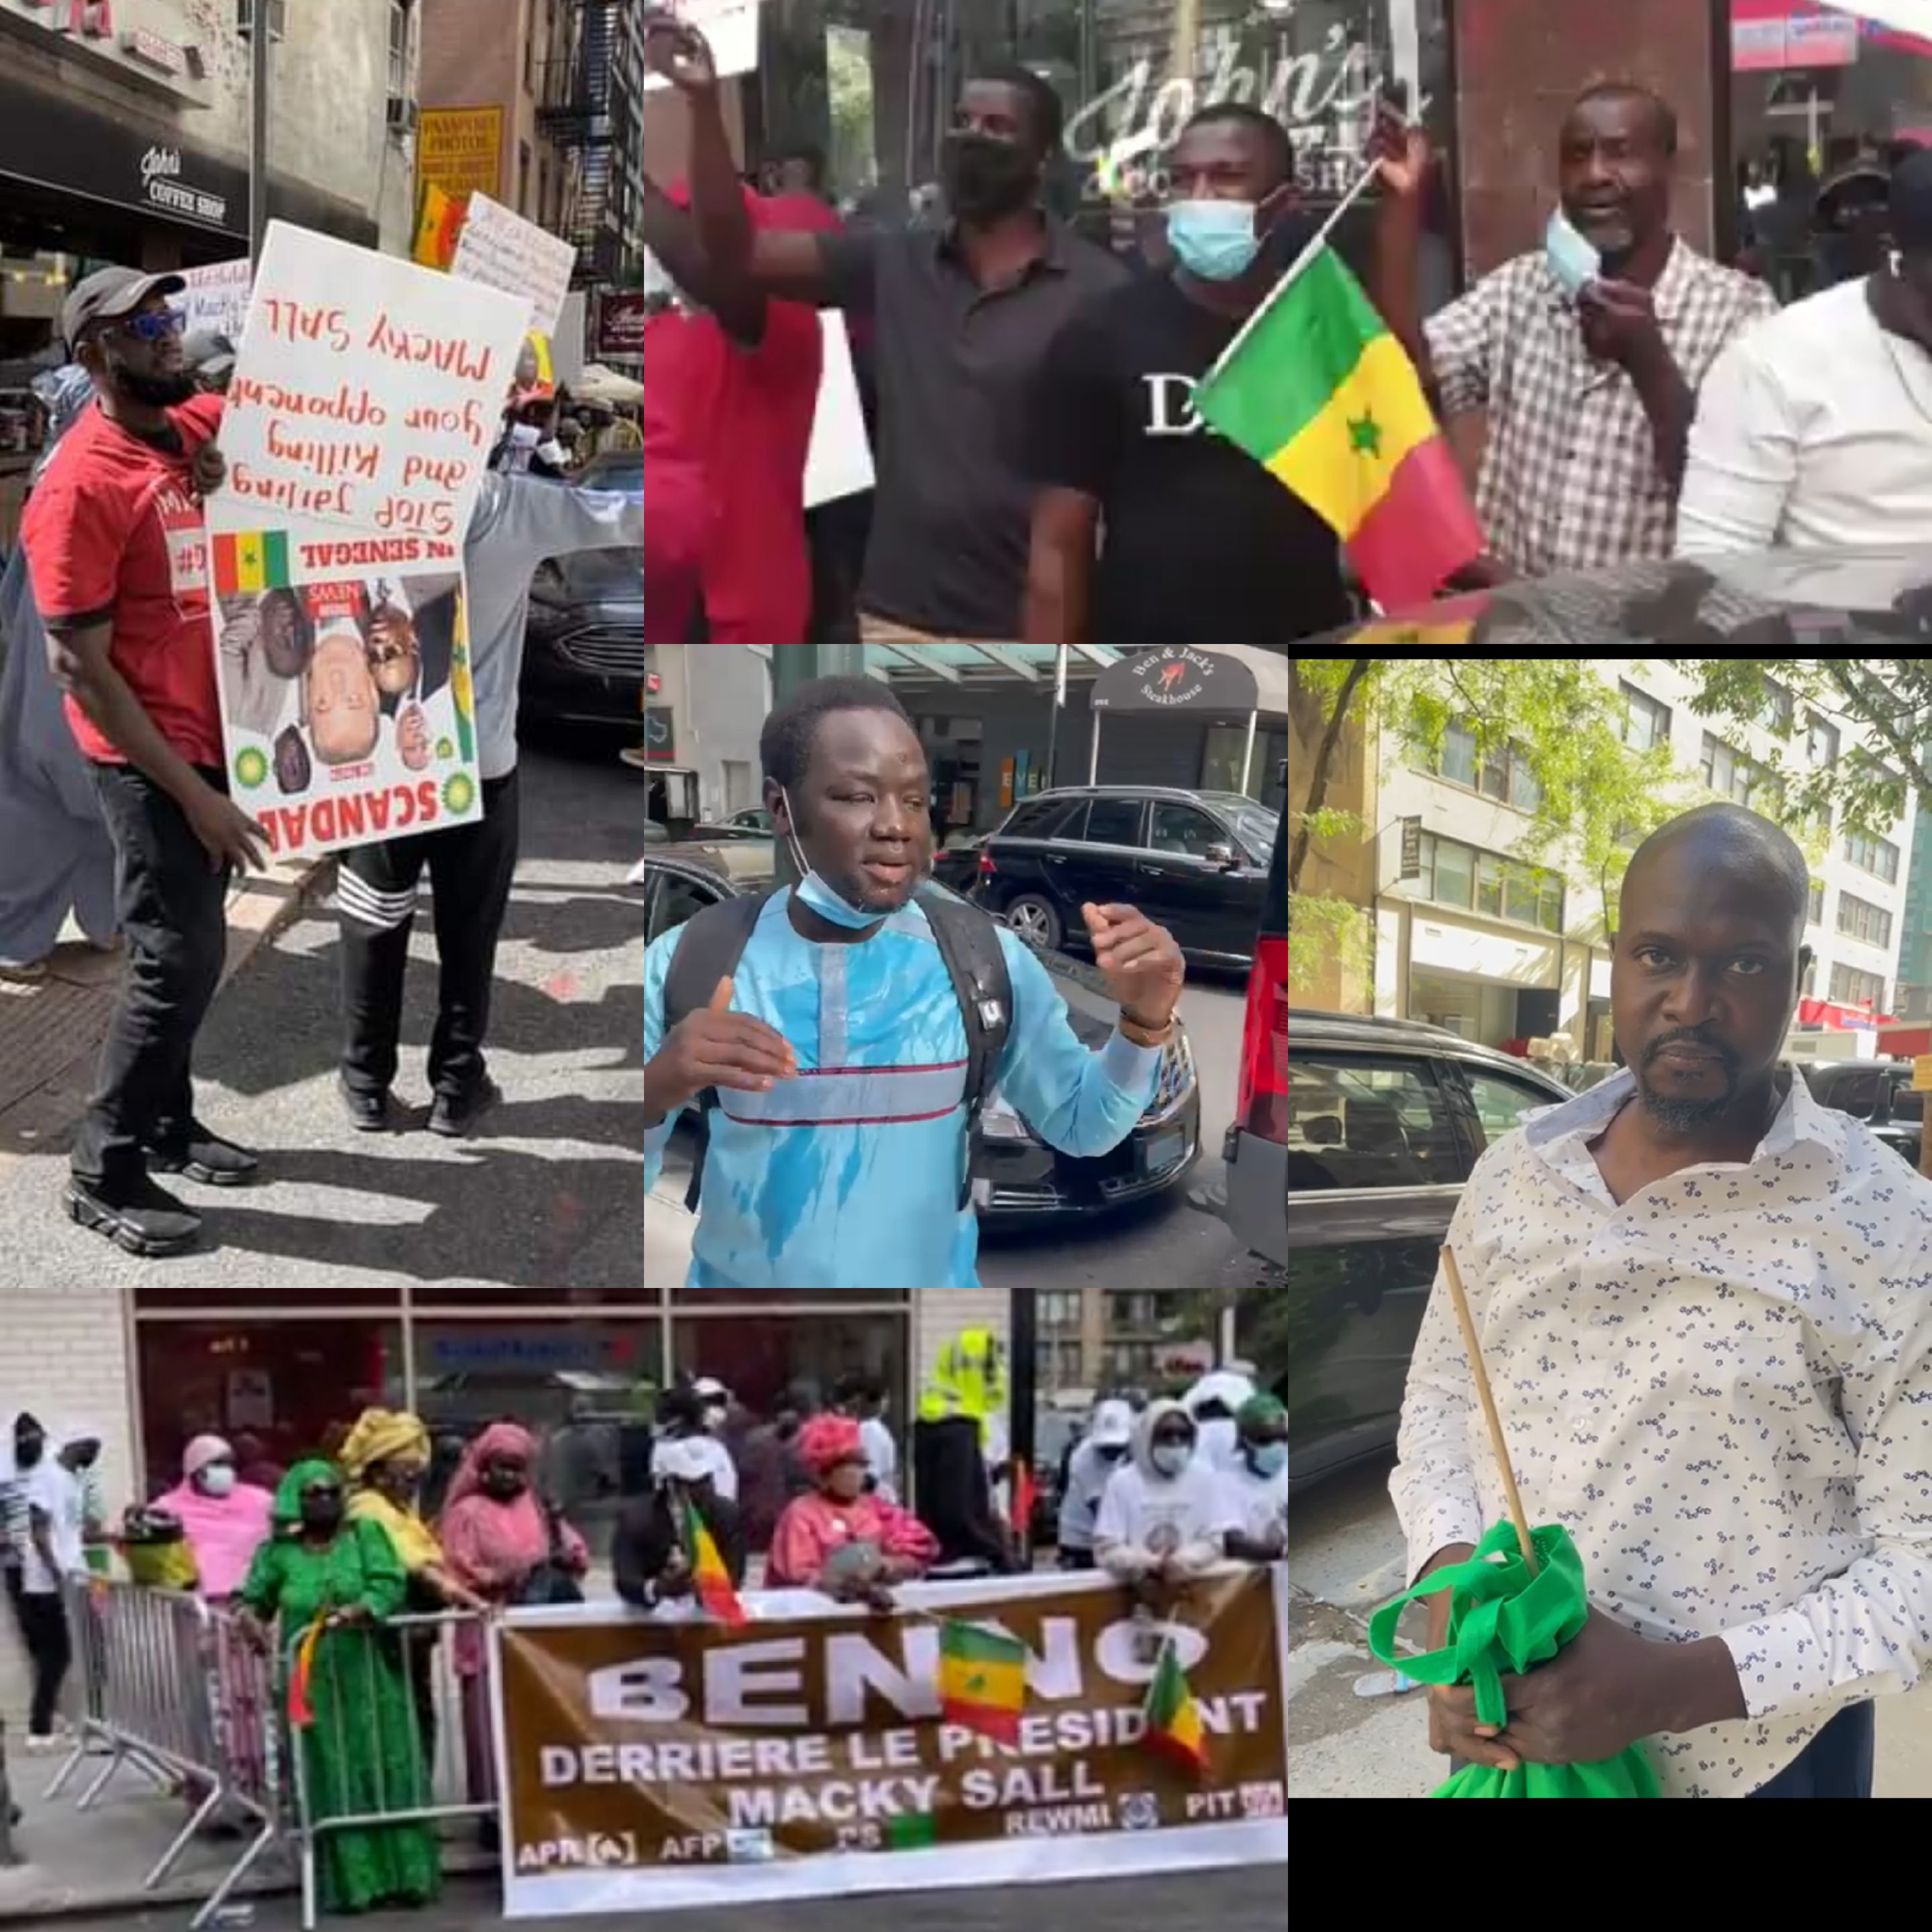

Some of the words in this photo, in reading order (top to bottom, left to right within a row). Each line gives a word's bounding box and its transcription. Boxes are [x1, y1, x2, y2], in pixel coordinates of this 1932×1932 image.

[150, 179, 195, 211] COFFEE
[196, 195, 225, 220] SHOP
[266, 299, 350, 352] SALL
[227, 376, 386, 426] opponent
[404, 399, 482, 445] your
[231, 462, 354, 515] Jailing
[403, 454, 466, 492] and
[300, 537, 420, 568] SENEGAL
[1132, 655, 1160, 676] Ben
[1162, 647, 1175, 659] &
[1179, 647, 1215, 676] Jack's
[1140, 683, 1203, 705] Steakhouse
[540, 1734, 831, 1785] DERRIERE
[848, 1728, 920, 1769] LE
[938, 1691, 1267, 1761] PESIDNT
[728, 1775, 939, 1826] MACKY
[962, 1762, 1106, 1809] SALL
[1185, 1789, 1235, 1819] PIT
[661, 1832, 720, 1861] AFP
